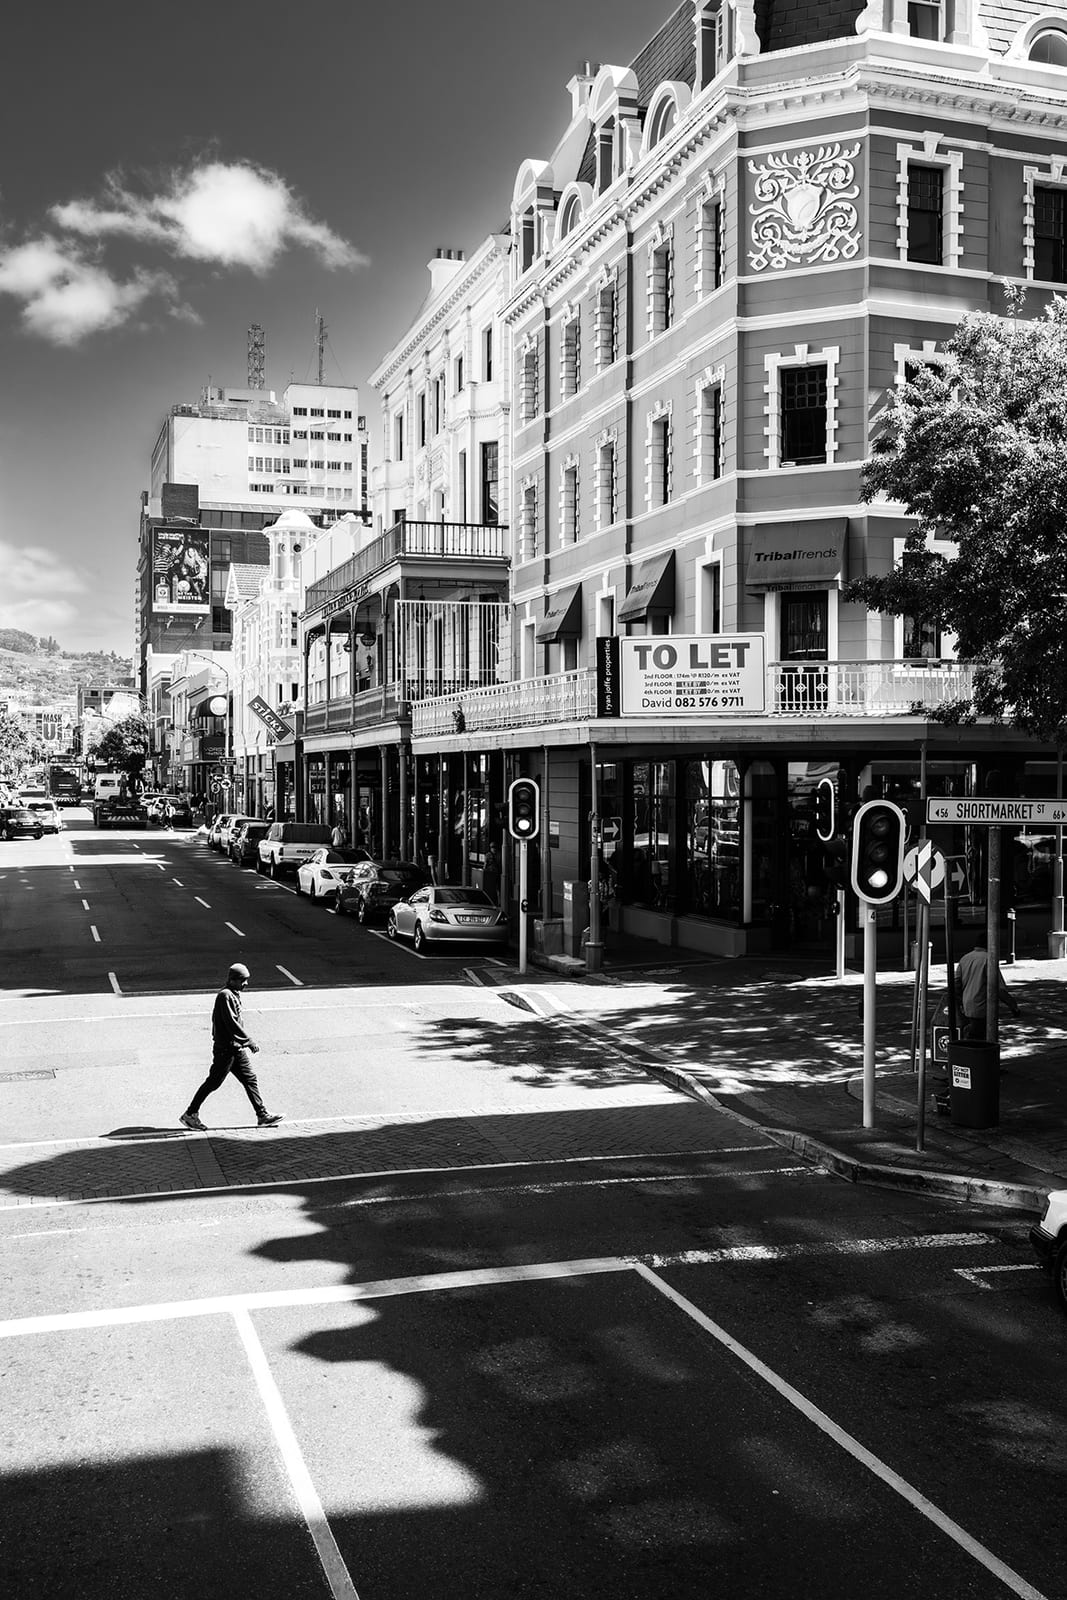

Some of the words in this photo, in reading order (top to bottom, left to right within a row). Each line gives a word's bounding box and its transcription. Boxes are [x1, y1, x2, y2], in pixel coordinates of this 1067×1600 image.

[754, 548, 837, 562] TribalTrends
[604, 640, 613, 675] properties
[634, 644, 678, 670] TO
[689, 642, 750, 669] LET
[604, 678, 613, 694] joffe
[605, 695, 613, 710] ryan
[642, 698, 672, 708] David
[675, 697, 696, 707] 082
[699, 697, 718, 707] 576
[721, 696, 744, 707] 9711
[43, 713, 62, 723] MASK
[940, 808, 949, 818] 56
[956, 803, 1034, 819] SHORTMARKET
[1036, 804, 1045, 814] ST
[1052, 810, 1061, 820] 66
